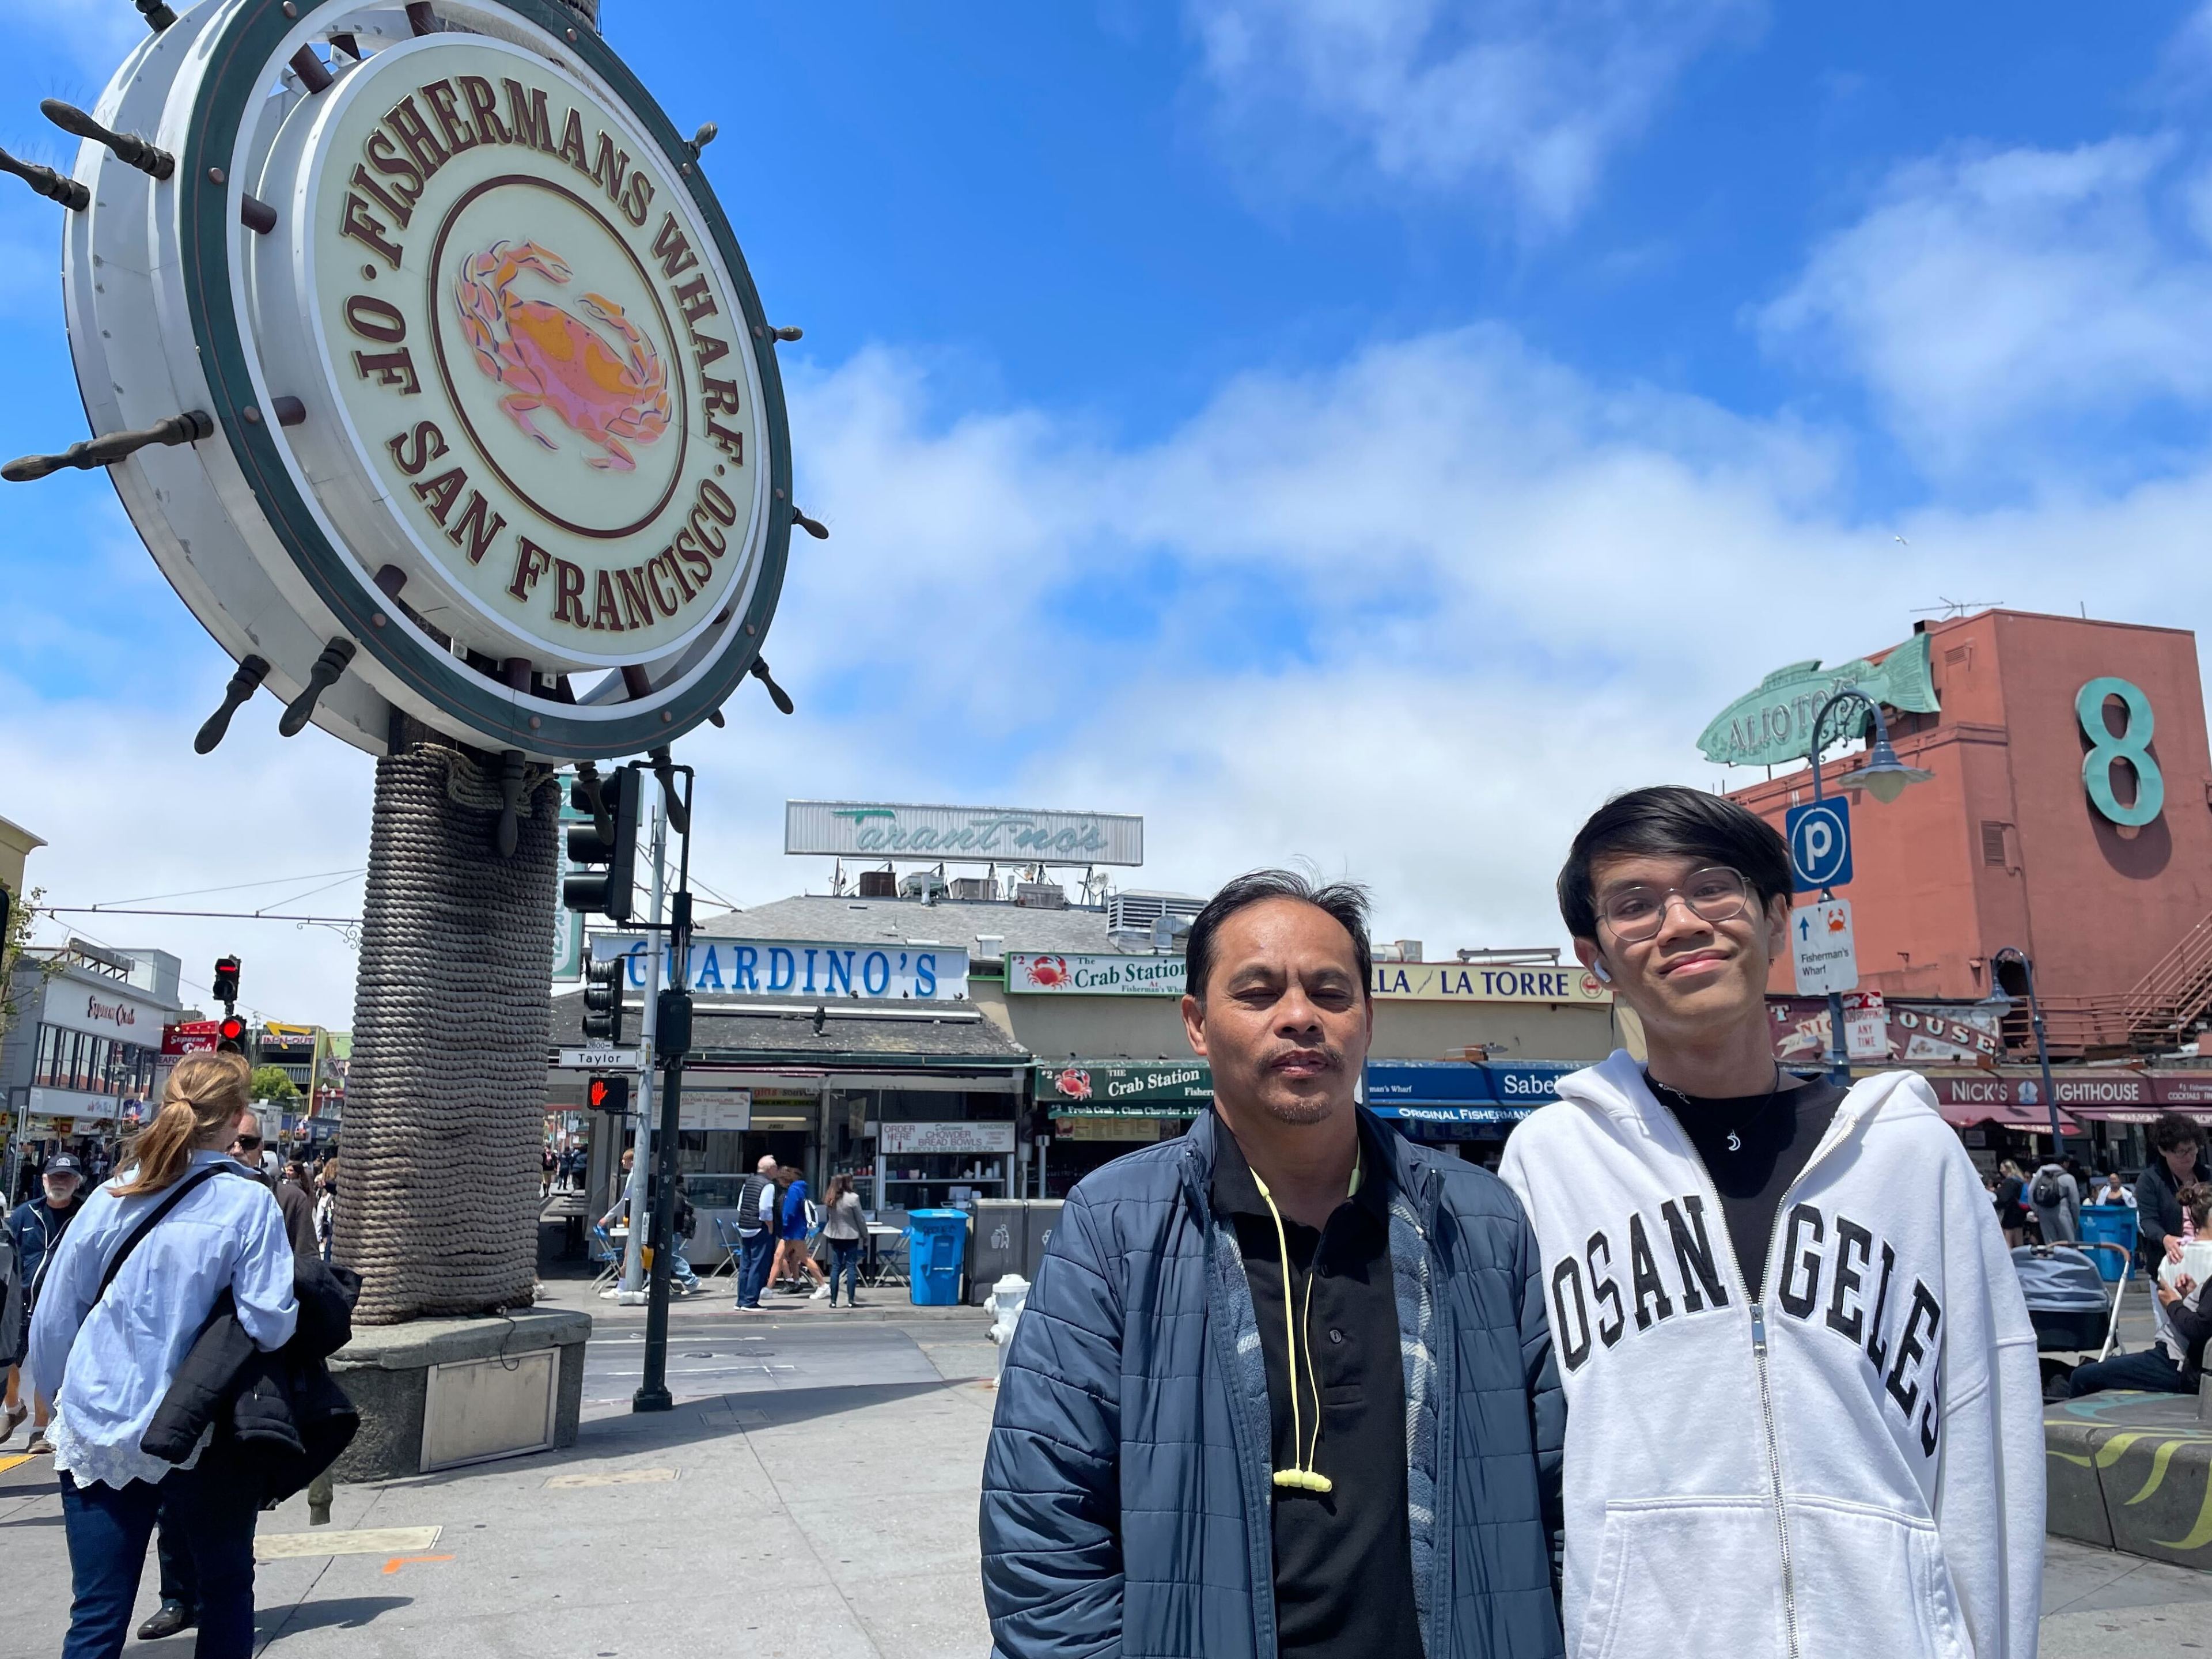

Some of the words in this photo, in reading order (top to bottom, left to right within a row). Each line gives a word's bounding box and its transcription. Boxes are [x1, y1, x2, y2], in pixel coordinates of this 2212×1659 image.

[342, 75, 655, 270] FISHERMANS
[649, 210, 744, 467] WHARF
[344, 294, 422, 395] OF
[385, 420, 506, 566] SAN
[505, 478, 738, 633] FRANCISCO
[1728, 675, 1858, 753] ALIOTO
[2075, 676, 2165, 827] 8
[1077, 957, 1096, 965] The
[1801, 948, 1850, 964] Fisherman's
[1802, 964, 1826, 976] Wharf
[1074, 965, 1120, 988] Crab
[1122, 984, 1165, 993] Fisherman's
[1372, 969, 1411, 993] LA
[1441, 970, 1474, 994] LA
[1480, 971, 1569, 997] TORRE
[1858, 1025, 1872, 1034] ANY
[1858, 1036, 1876, 1047] TIME
[578, 1053, 622, 1065] Taylor
[1108, 1077, 1144, 1097] Crab
[1147, 1069, 1200, 1089] Station
[1391, 1085, 1413, 1093] Wharf
[1504, 1074, 1559, 1094] Sabe
[1951, 1080, 2008, 1102] NICK'S
[2053, 1082, 2139, 1101] IGHTHOUSE
[1067, 1105, 1093, 1114] Fresh
[1093, 1105, 1115, 1115] Crab
[1121, 1106, 1143, 1115] Clam
[1145, 1107, 1180, 1115] Chowder
[1399, 1107, 1459, 1120] ORIGINAL
[884, 1124, 915, 1133] ORDER
[888, 1132, 911, 1141] HERE
[925, 1131, 971, 1139] CHOWDER
[918, 1138, 948, 1146] BREAD
[950, 1138, 982, 1146] BOWLS
